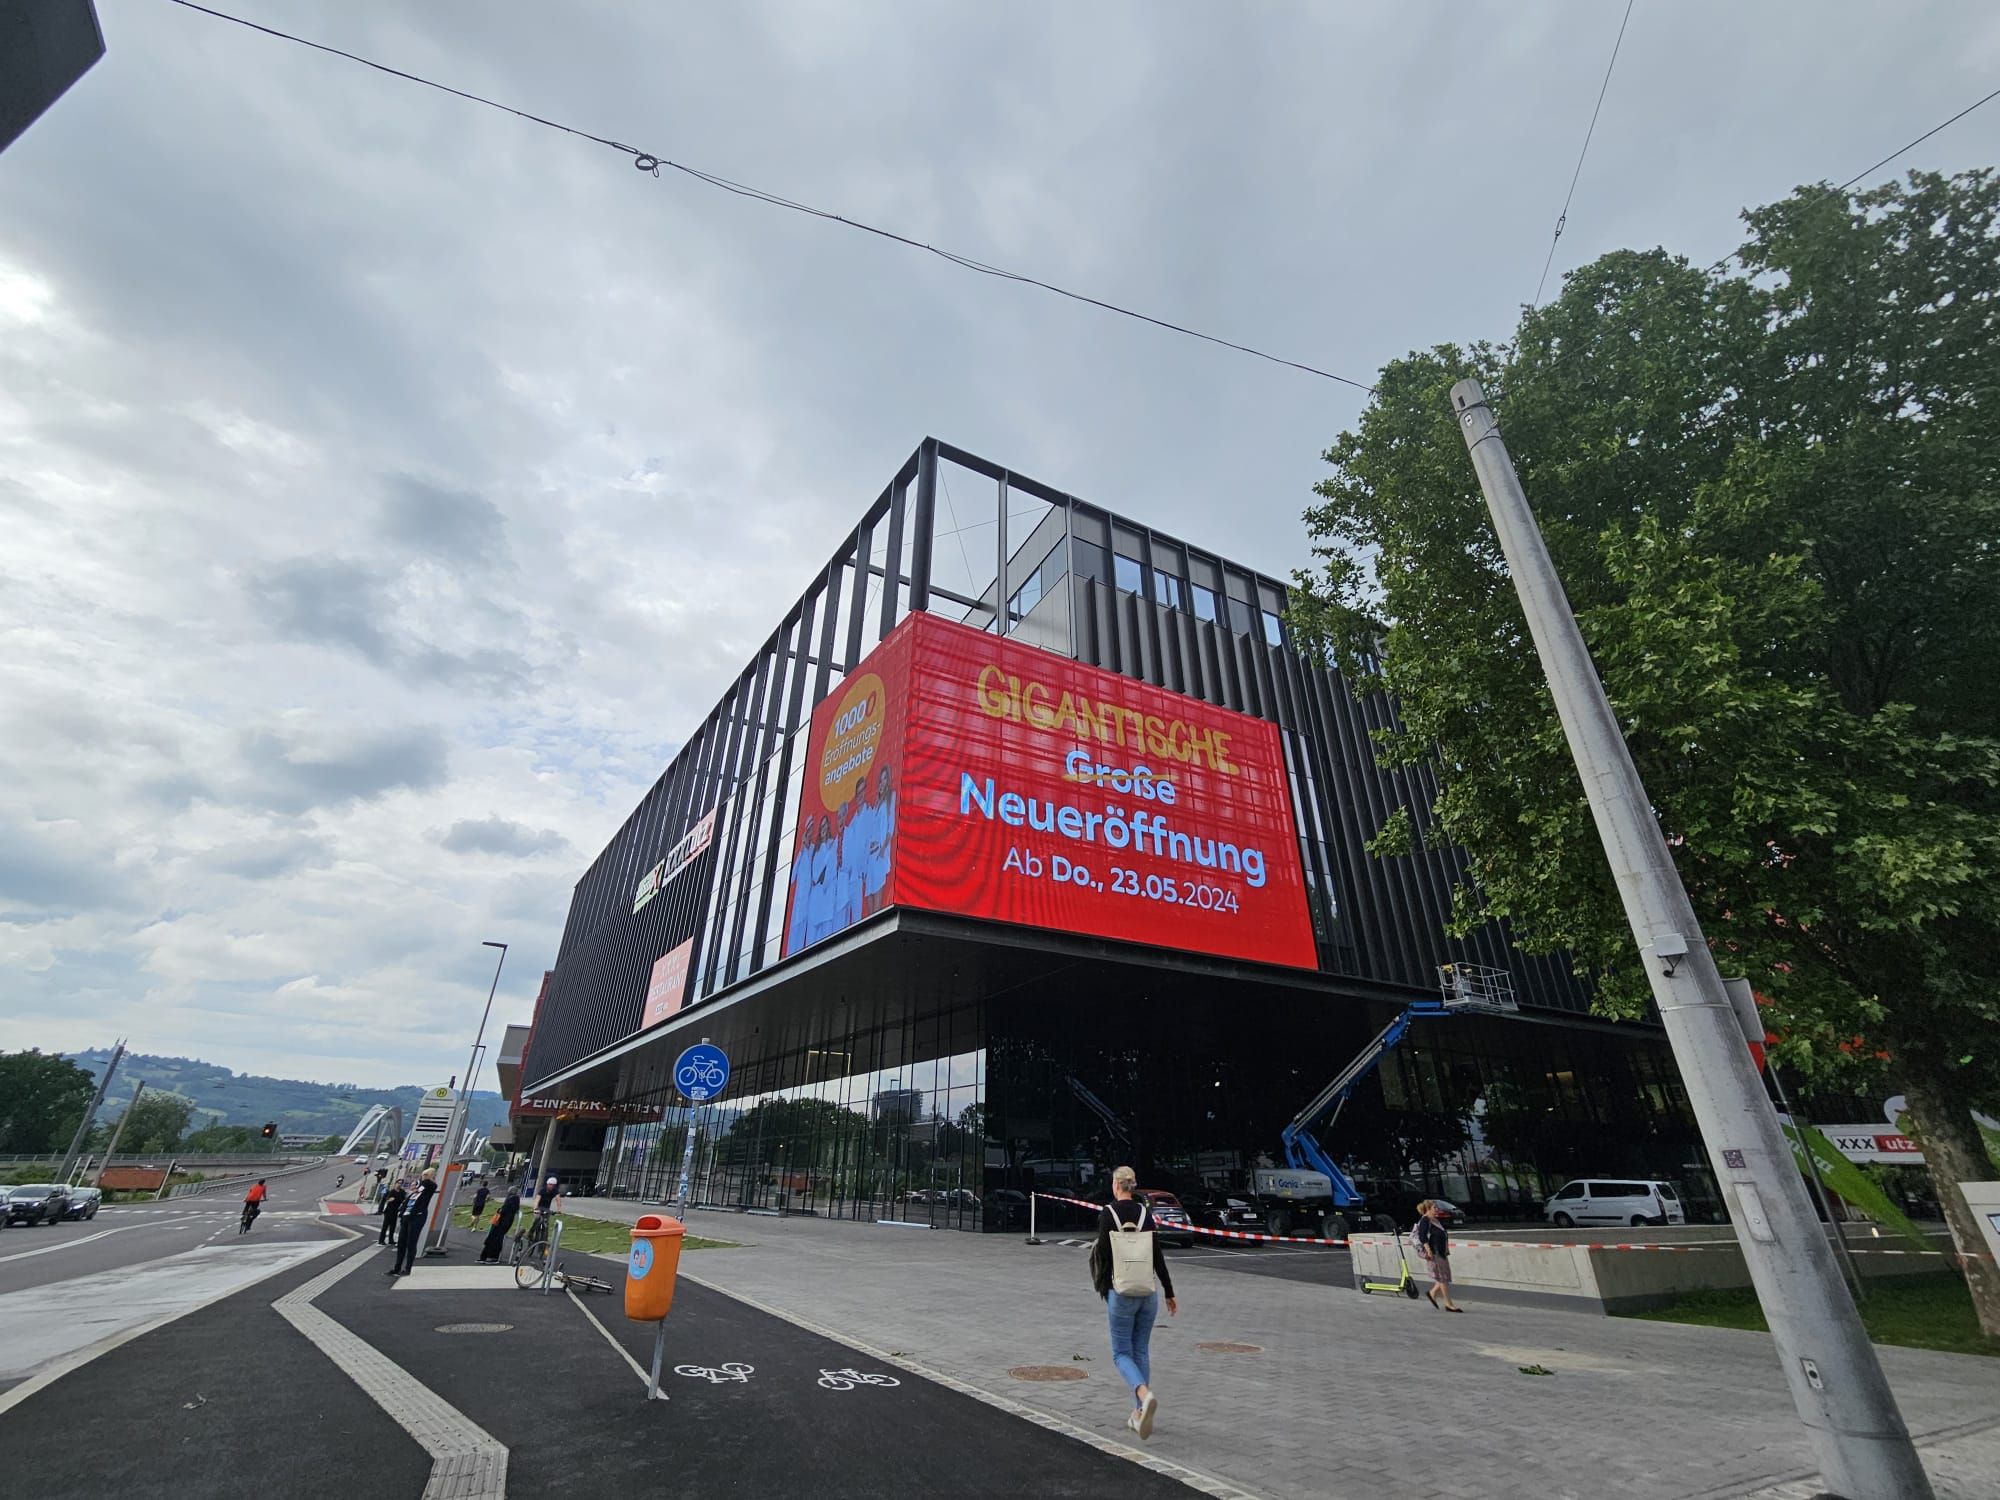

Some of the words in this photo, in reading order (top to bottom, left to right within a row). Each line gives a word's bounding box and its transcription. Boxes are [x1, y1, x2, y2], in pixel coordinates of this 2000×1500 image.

[824, 723, 881, 768] Eröffnungs-
[977, 664, 1240, 775] GIGANTISCHE
[824, 745, 873, 785] angebote
[1065, 750, 1177, 805] Große
[960, 771, 1267, 888] Neueröffnung
[1002, 847, 1043, 877] Ab
[1052, 855, 1104, 893] Do.,
[1110, 867, 1240, 914] 23.05.2024
